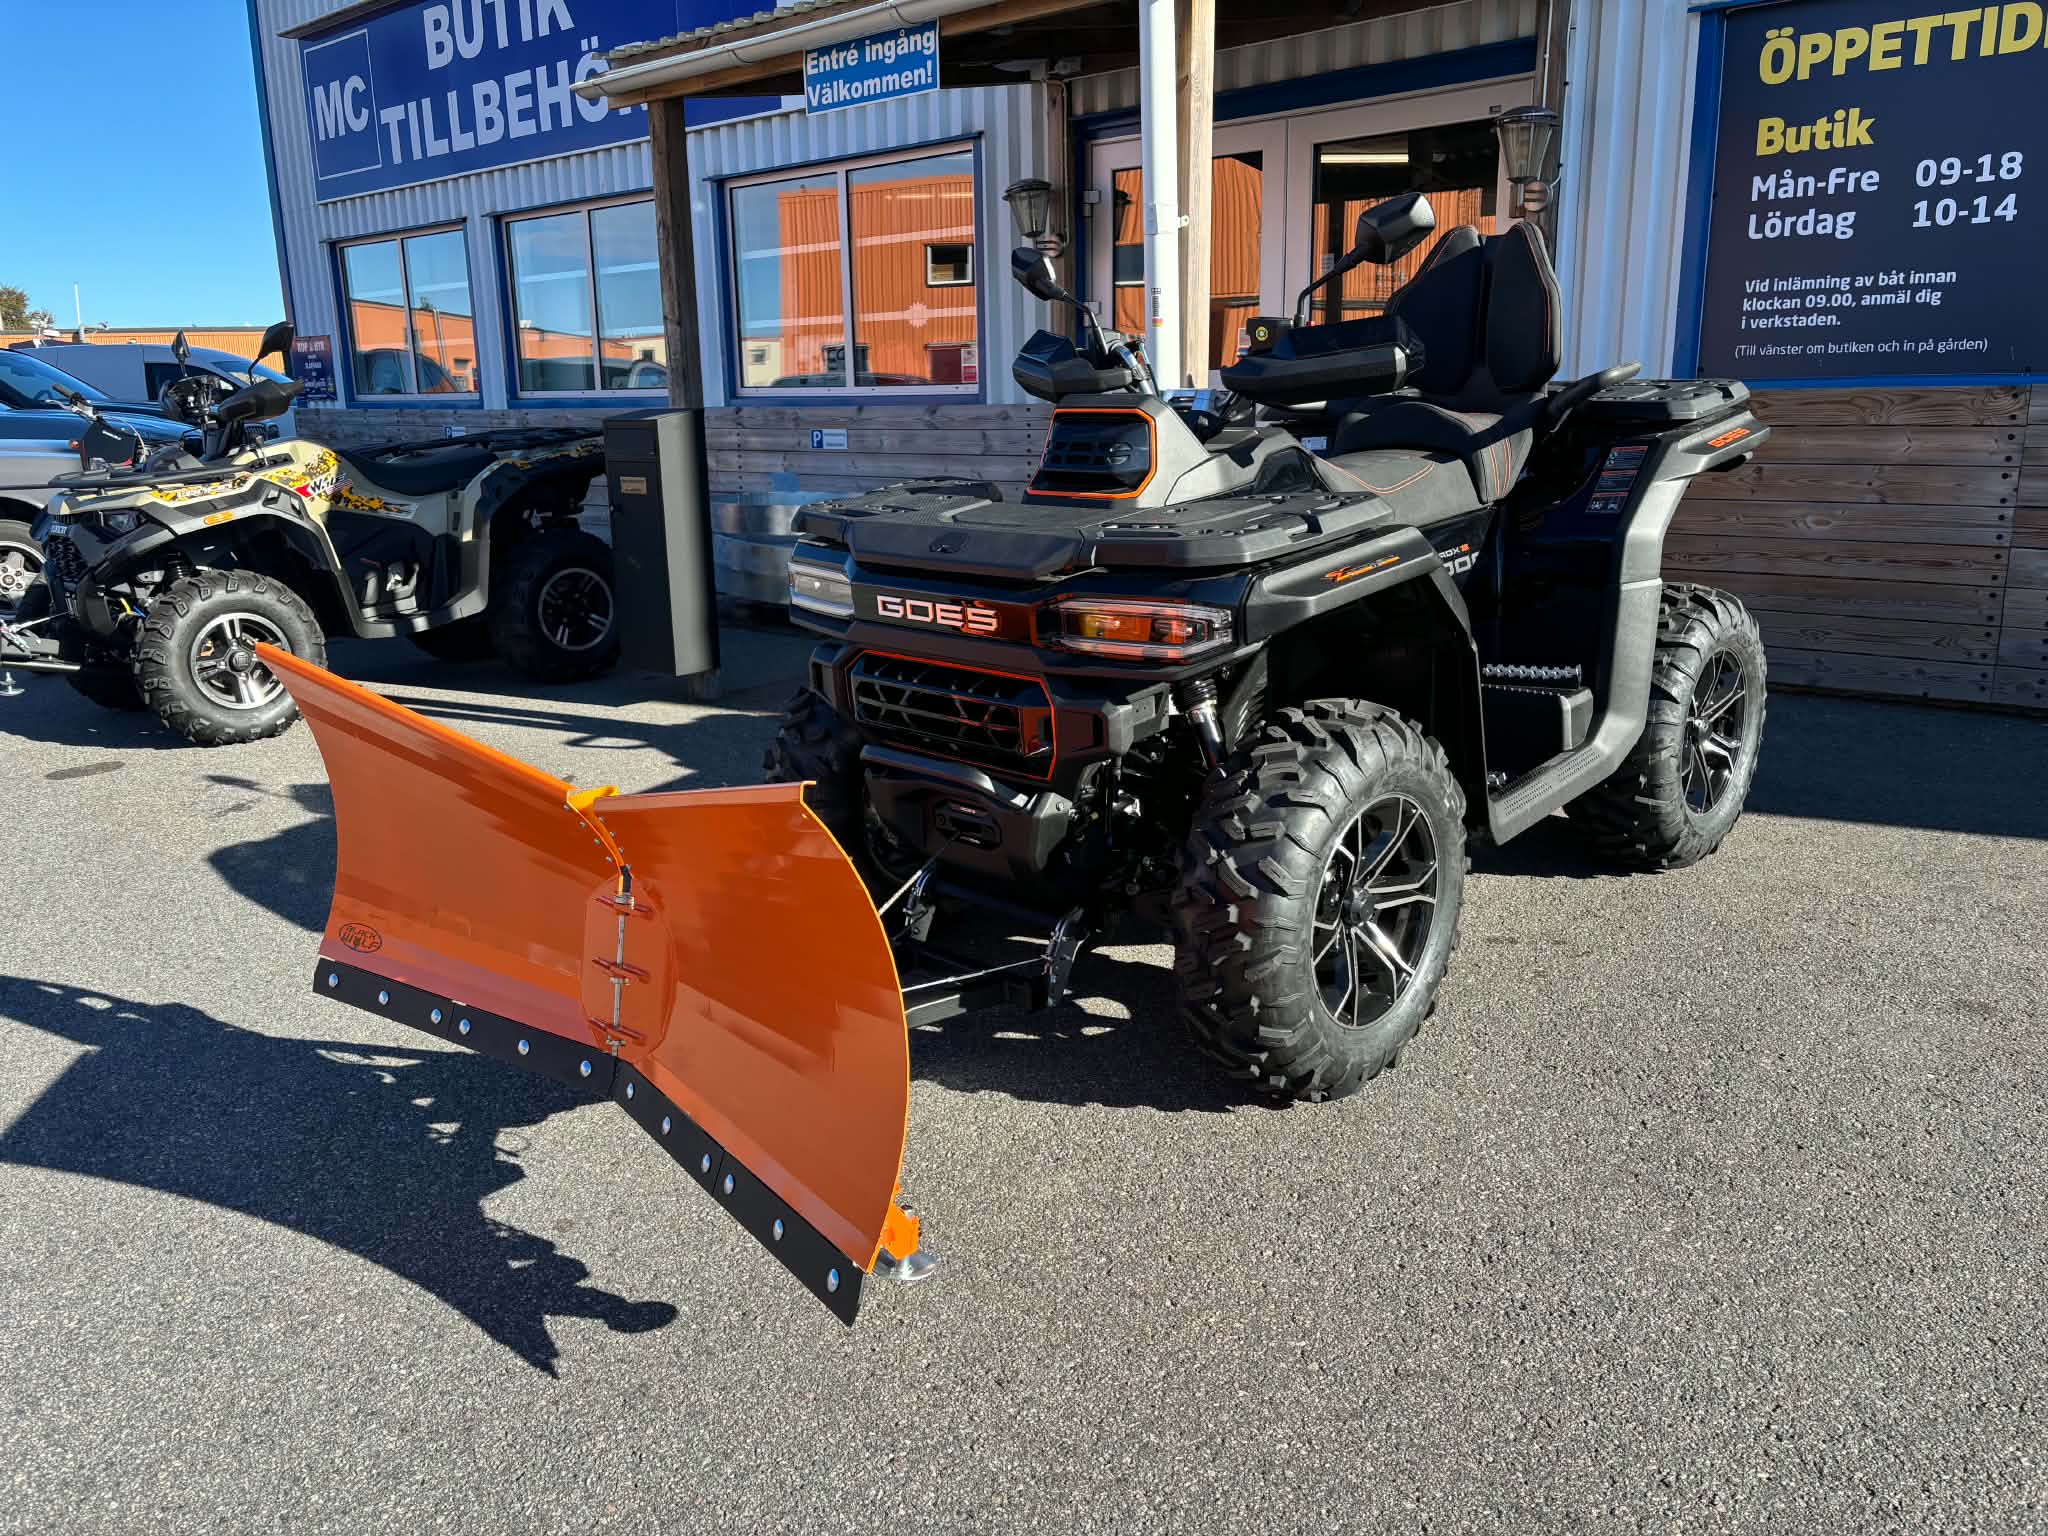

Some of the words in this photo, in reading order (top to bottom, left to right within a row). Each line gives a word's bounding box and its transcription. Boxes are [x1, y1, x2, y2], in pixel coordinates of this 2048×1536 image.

[807, 43, 859, 75] Entré
[865, 29, 935, 64] ingång
[1759, 1, 2048, 85] ÖPPETTID
[380, 35, 648, 165] TILLBEHÖ
[807, 59, 933, 107] Välkommen!
[313, 75, 369, 141] MC
[1756, 107, 1876, 156] Butik
[1751, 167, 1880, 202] Mån-Fre
[1915, 151, 2024, 188] 09-18
[1748, 208, 1857, 240] Lördag
[1912, 193, 2018, 228] 10-14
[1743, 296, 1801, 311] klockan
[1805, 293, 1857, 308] 09.00,
[1860, 289, 1911, 306] anmäl
[1914, 288, 1942, 306] dig
[1745, 278, 1770, 293] Vid
[1773, 275, 1851, 291] inlämning
[1854, 275, 1875, 288] av
[1878, 269, 1906, 286] båt
[1909, 270, 1957, 284] innan
[1741, 316, 1746, 329] i
[1750, 313, 1841, 328] verkstaden.
[1735, 344, 1756, 359] (Till
[1759, 344, 1803, 355] vänster
[1806, 345, 1825, 354] om
[1828, 341, 1874, 353] butiken
[1877, 340, 1900, 353] och
[1903, 339, 1915, 351] in
[1918, 338, 1934, 353] på
[1937, 338, 1989, 353] gården)
[813, 431, 822, 448] P
[877, 595, 998, 632] GOES
